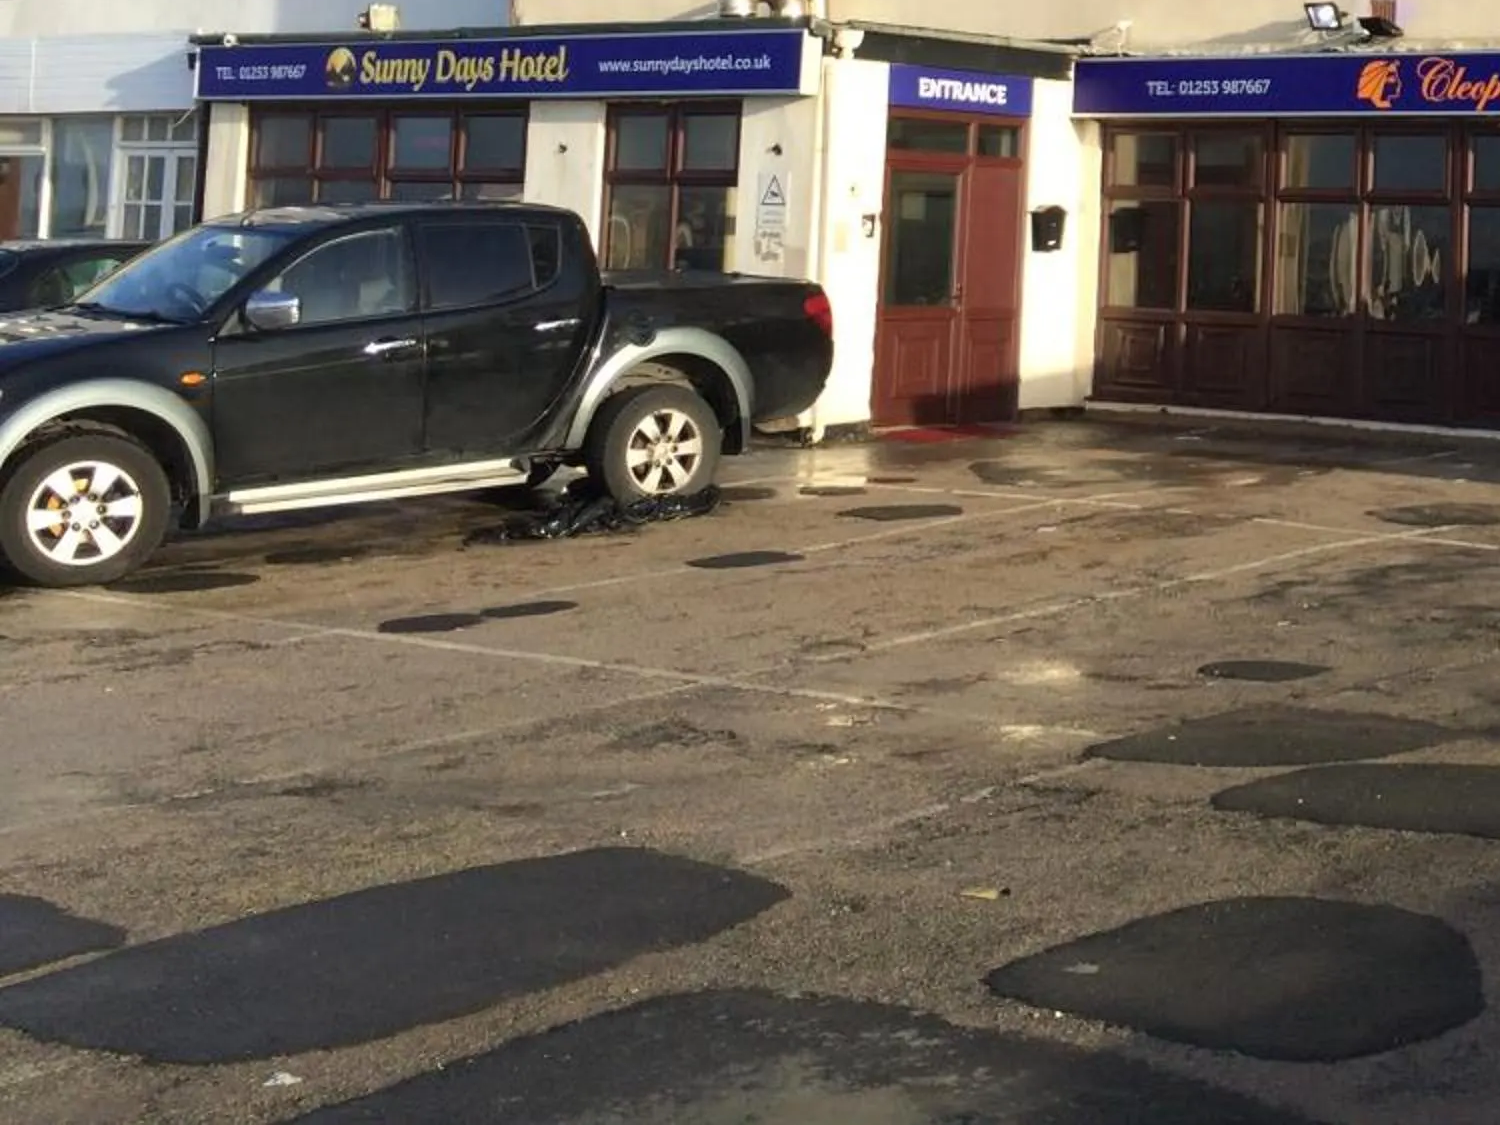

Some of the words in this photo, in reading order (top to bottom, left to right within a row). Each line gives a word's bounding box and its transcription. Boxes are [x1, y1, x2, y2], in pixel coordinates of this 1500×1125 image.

[359, 51, 432, 92] Sunny
[435, 49, 494, 90] Days
[499, 45, 569, 83] Hotel
[598, 54, 771, 75] www.sunnydayshotel.co.uk
[918, 77, 1007, 104] ENTRANCE
[1147, 81, 1176, 96] TEL:
[1178, 80, 1219, 95] 01253
[1222, 79, 1271, 95] 987667
